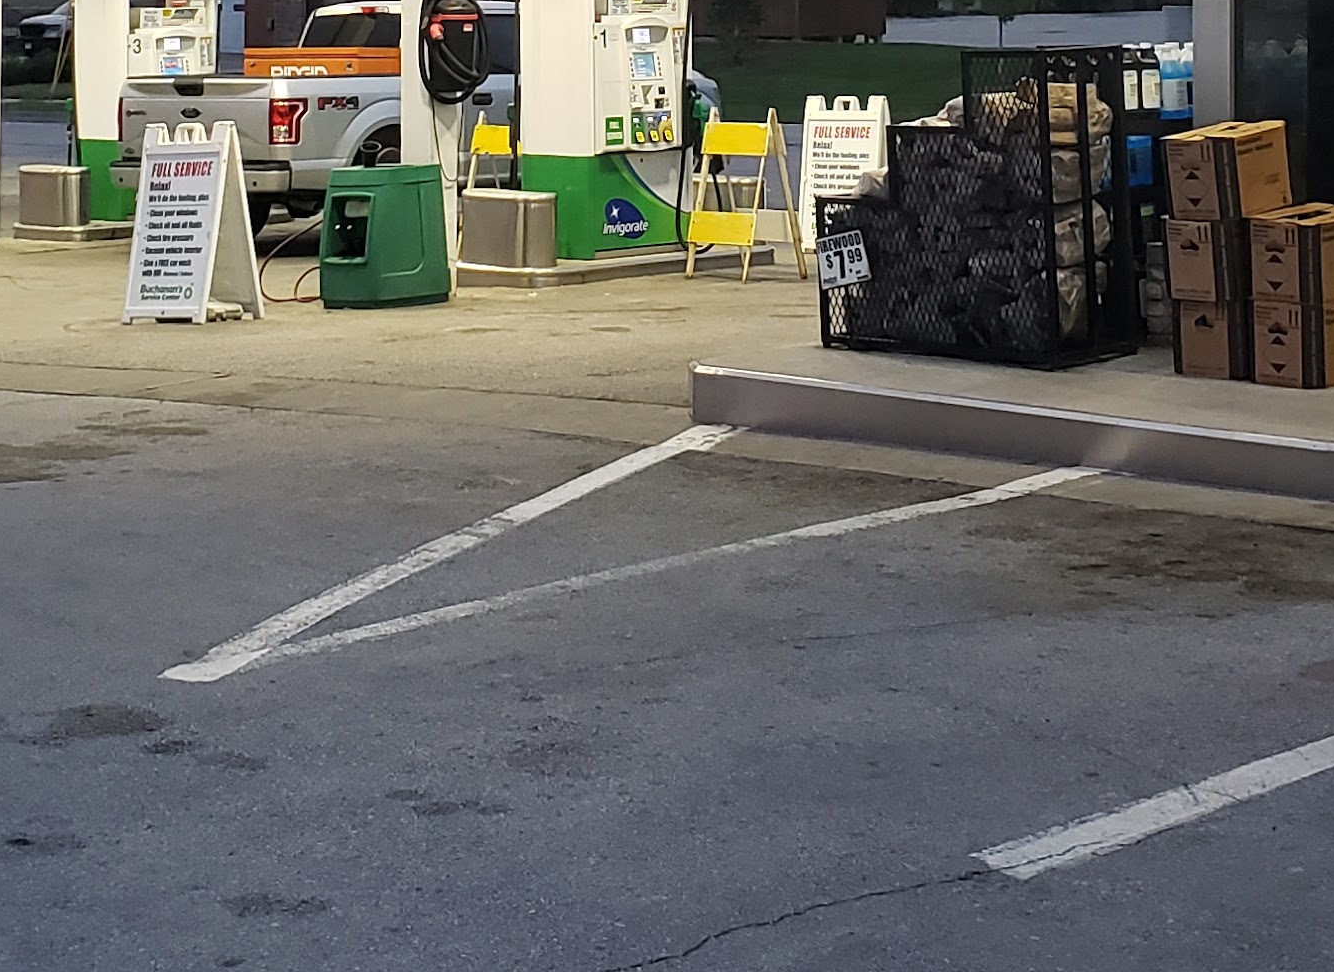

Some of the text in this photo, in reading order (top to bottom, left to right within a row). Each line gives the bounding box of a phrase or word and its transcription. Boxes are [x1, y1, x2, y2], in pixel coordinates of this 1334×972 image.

[133, 39, 142, 54] 3
[600, 29, 607, 48] 1
[317, 96, 359, 110] FX4
[813, 126, 871, 139] FULL SERVICE
[151, 160, 214, 178] FULL SERVICE
[603, 219, 649, 237] Invigorate
[817, 232, 861, 254] FIREWOOD
